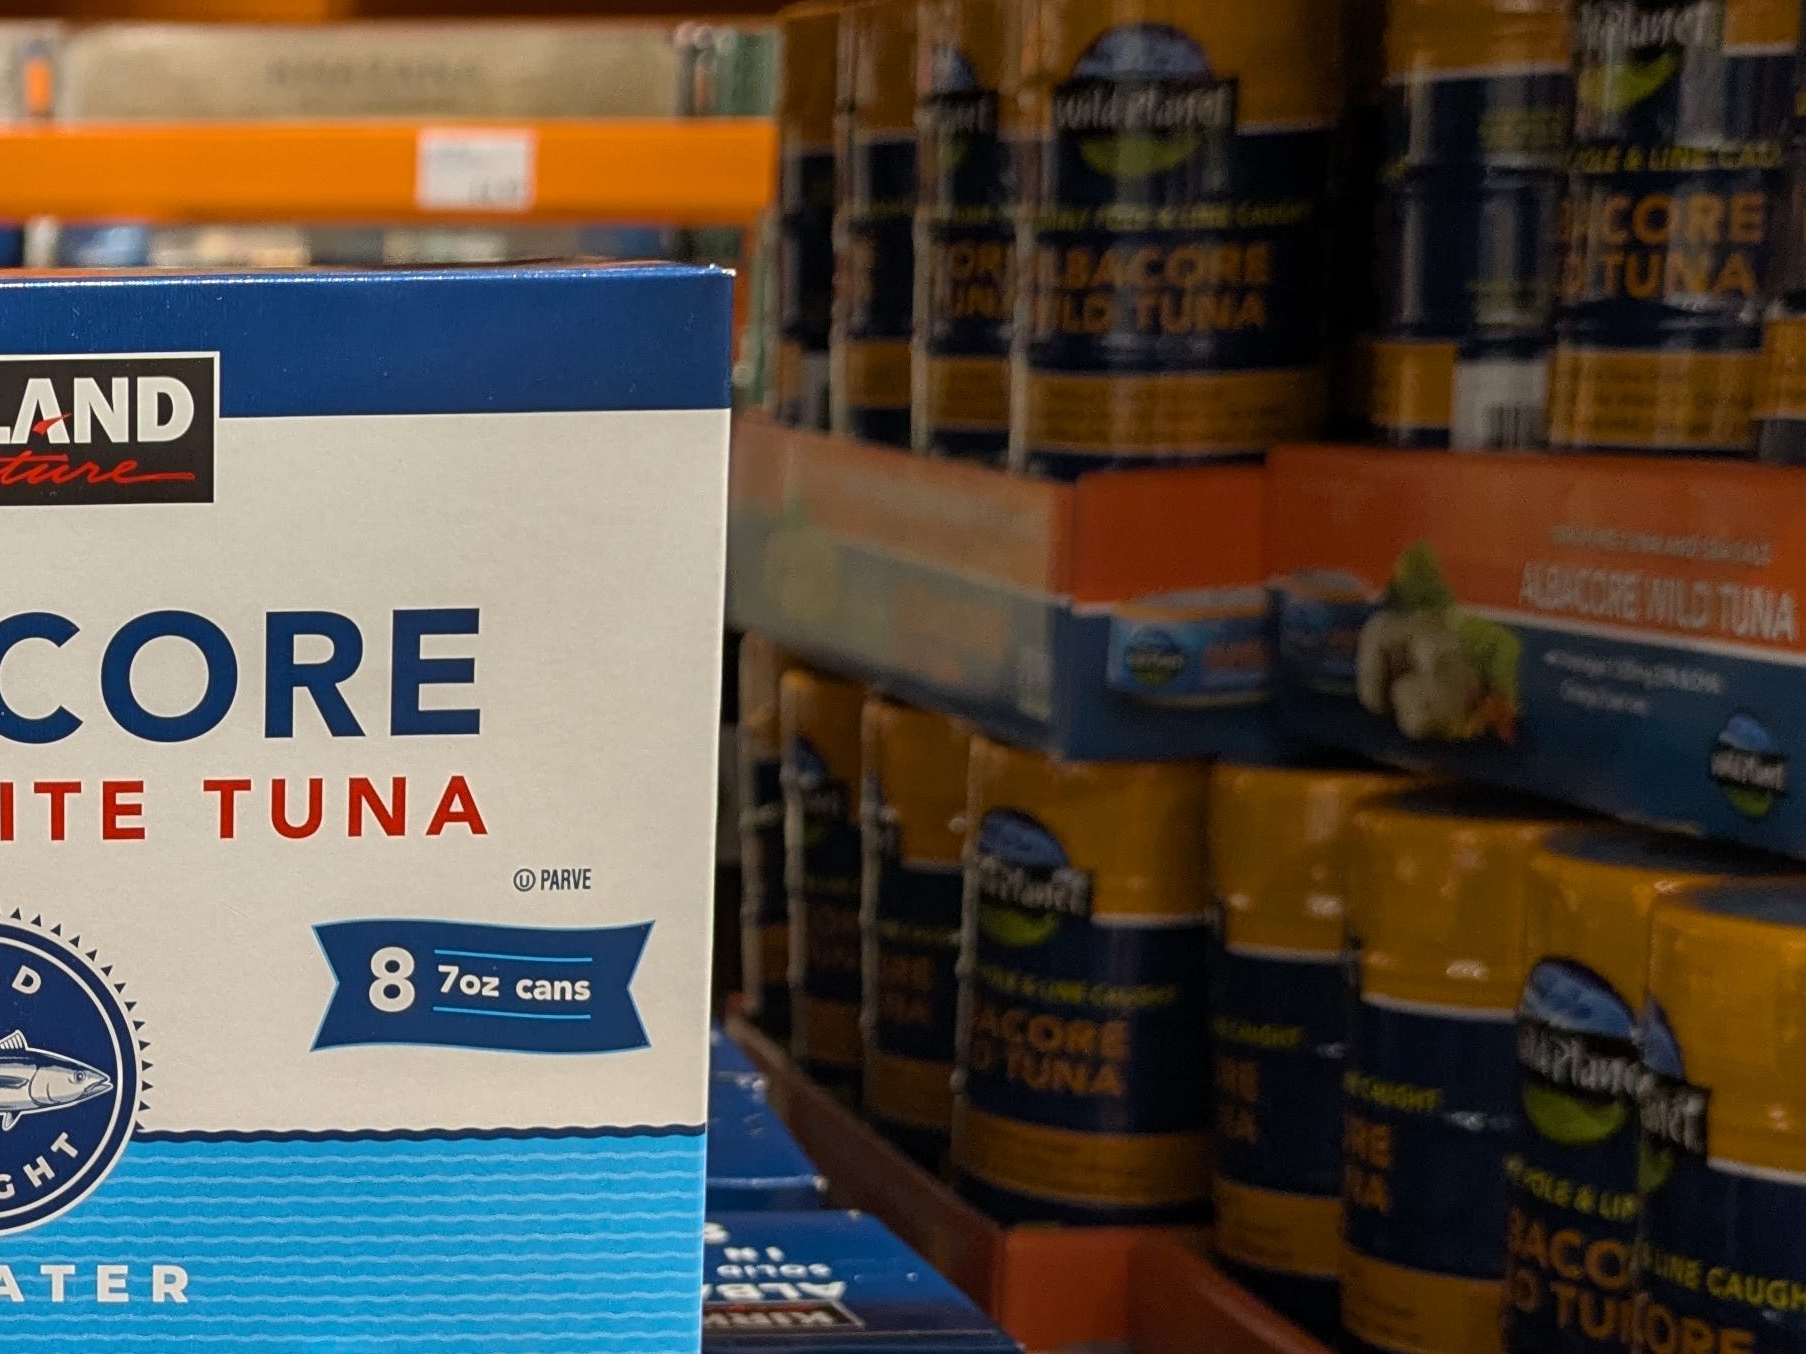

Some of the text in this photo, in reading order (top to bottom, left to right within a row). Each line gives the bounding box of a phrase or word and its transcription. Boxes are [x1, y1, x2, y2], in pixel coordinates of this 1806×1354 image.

[203, 775, 488, 840] TUNA
[540, 868, 592, 891] PARVE
[368, 946, 591, 1012] 8 7oz cans
[1705, 1266, 1806, 1311] CAUGH
